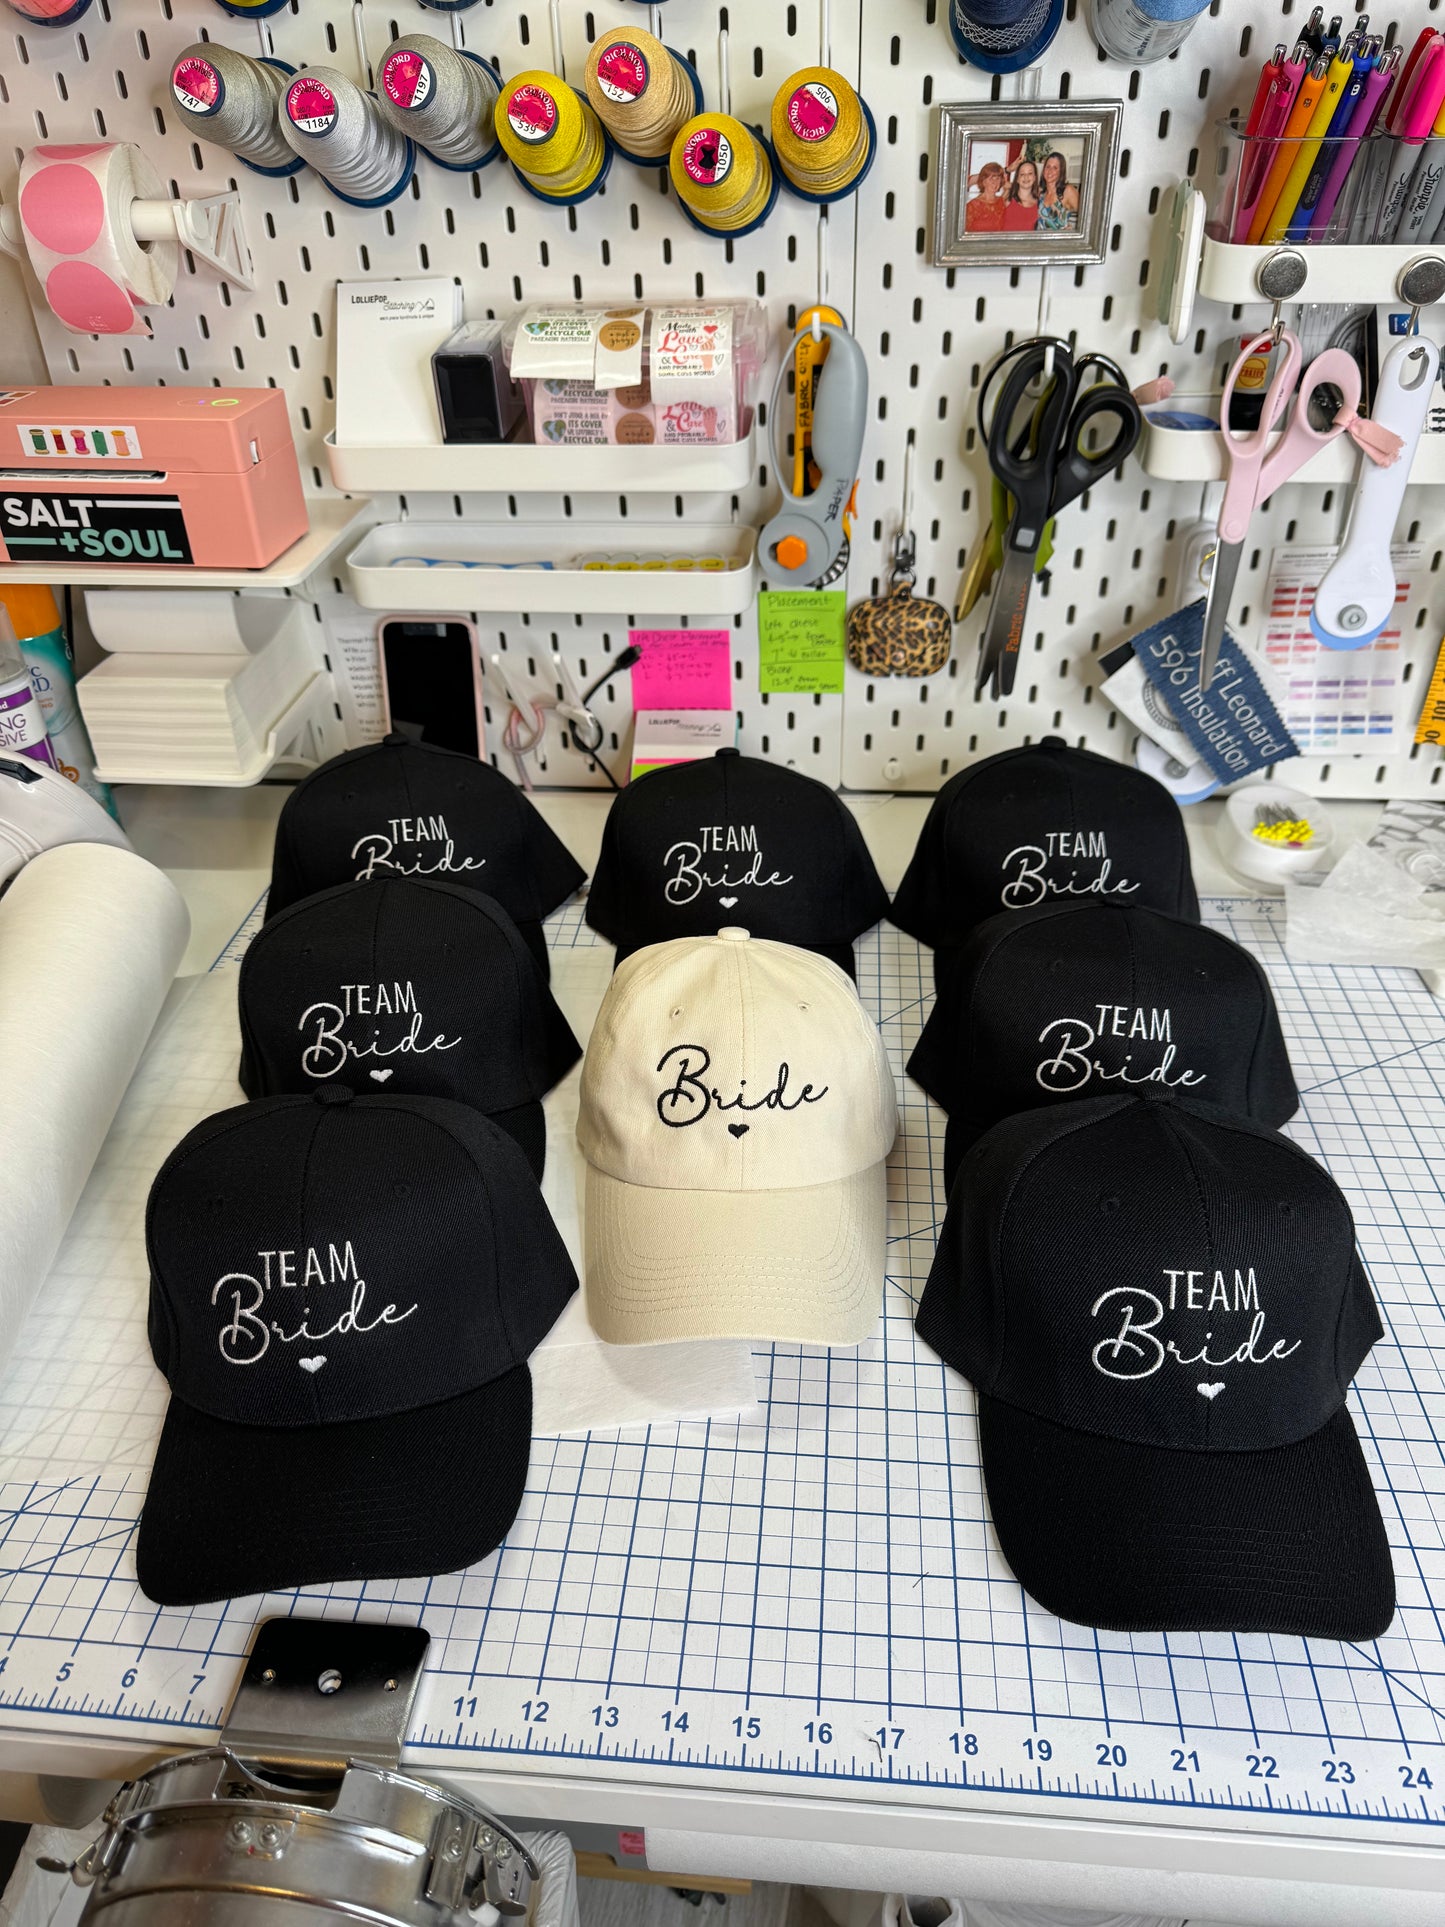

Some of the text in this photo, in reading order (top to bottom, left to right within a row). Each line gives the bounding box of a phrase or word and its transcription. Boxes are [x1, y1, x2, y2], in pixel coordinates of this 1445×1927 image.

[180, 60, 200, 73] RICH
[386, 54, 411, 77] WORD
[604, 48, 643, 81] RICH WORD
[181, 92, 200, 108] 747
[290, 80, 330, 105] RICH WORD
[414, 74, 428, 102] 1197
[607, 83, 625, 99] 152
[815, 86, 831, 104] 905
[306, 117, 330, 130] 1184
[517, 121, 537, 134] 539
[790, 101, 826, 138] RICH WORD
[685, 132, 708, 178] RICH WORD
[717, 144, 729, 171] 1050
[1415, 163, 1442, 212] Sharpie
[657, 331, 704, 353] Love
[800, 379, 810, 428] FABRIC
[564, 436, 593, 444] RECYCLE
[568, 420, 602, 428] ITS COVER
[3, 498, 94, 528] SALT
[824, 479, 849, 522] PAPER
[1150, 635, 1250, 772] 596 Insulation
[1218, 677, 1287, 758] Leonard
[388, 815, 449, 844] TEAM
[700, 825, 759, 853] TEAM
[1045, 831, 1107, 858] TEAM
[351, 834, 486, 881] Bride
[663, 842, 793, 905] Bride
[1001, 845, 1141, 909] Bride
[340, 981, 417, 1017] TEAM
[298, 1002, 462, 1078] Bride
[1096, 1004, 1171, 1042] TEAM
[1036, 1018, 1207, 1092] Bride
[656, 1044, 829, 1128] Bride
[257, 1240, 359, 1290] TEAM
[1163, 1268, 1260, 1311] TEAM
[211, 1273, 418, 1365] Bride
[1091, 1286, 1302, 1380] Bride
[55, 1662, 74, 1682] 5
[121, 1668, 138, 1688] 6
[189, 1674, 206, 1695] 7
[453, 1696, 478, 1718] 11
[521, 1700, 550, 1722] 12
[591, 1705, 620, 1728] 13
[660, 1710, 690, 1733] 14
[732, 1715, 761, 1739] 15
[803, 1721, 833, 1745] 16
[875, 1726, 905, 1750] 17
[949, 1732, 979, 1756] 18
[1022, 1738, 1053, 1762] 19
[1096, 1743, 1128, 1768] 20
[1169, 1749, 1201, 1773] 21
[1245, 1754, 1280, 1779] 22
[1321, 1760, 1357, 1784] 23
[1397, 1765, 1434, 1790] 24
